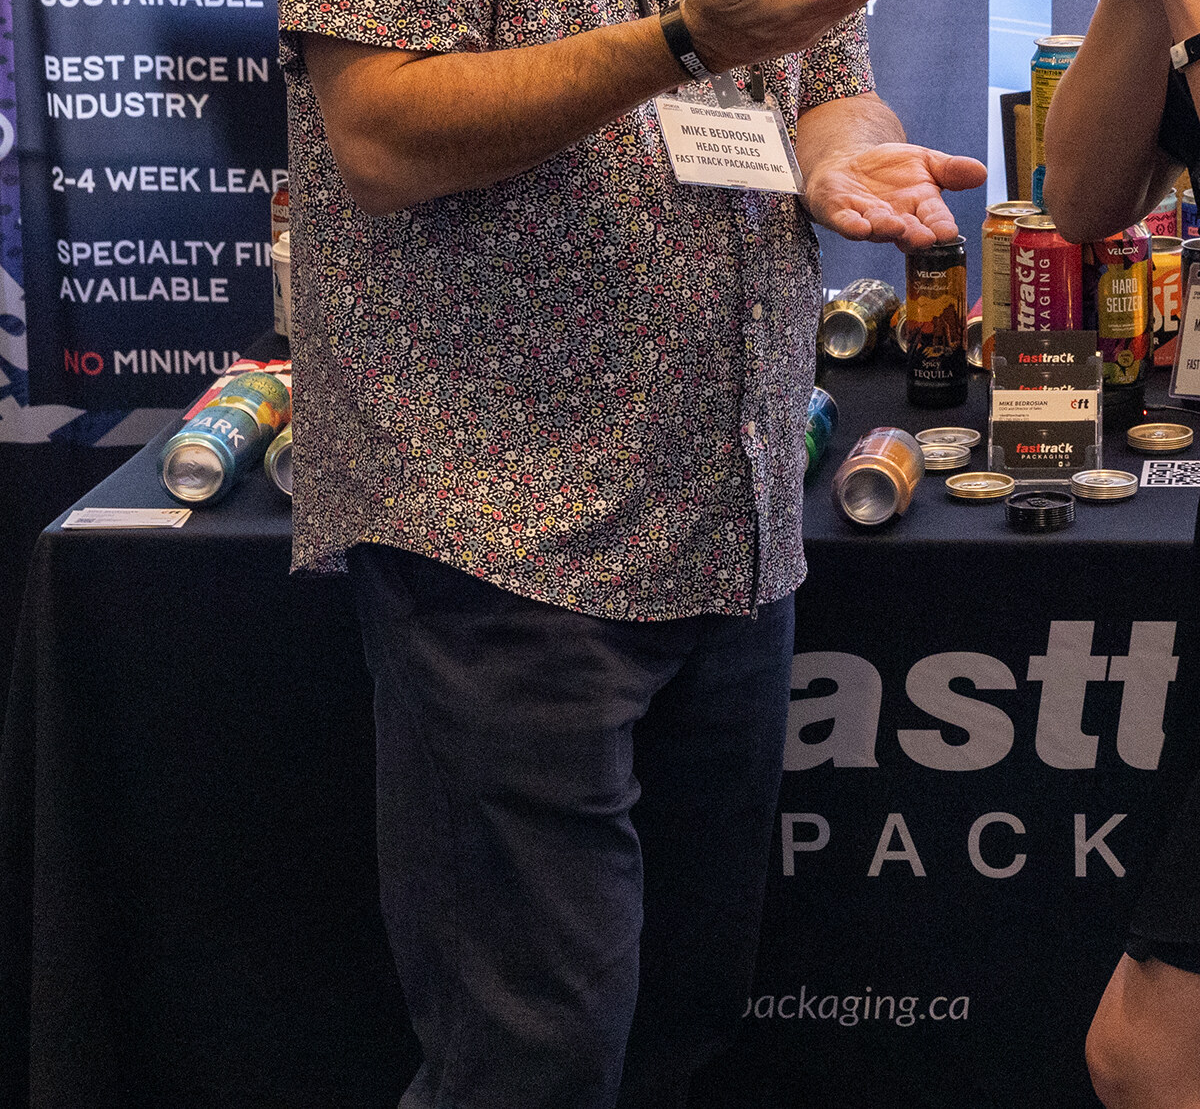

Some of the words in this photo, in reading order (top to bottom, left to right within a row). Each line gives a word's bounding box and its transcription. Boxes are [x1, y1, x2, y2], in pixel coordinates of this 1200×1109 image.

[45, 55, 126, 82] BEST
[134, 56, 229, 82] PRICE
[237, 56, 269, 82] IN
[47, 92, 208, 119] INDUSTRY
[680, 124, 709, 138] MIKE
[708, 127, 766, 144] BEDROSIAN
[695, 141, 720, 153] HEAD
[721, 144, 733, 155] OF
[734, 146, 761, 158] SALES
[675, 153, 695, 165] FAST
[696, 155, 724, 167] TRACK
[724, 157, 770, 172] PACKAGING
[52, 168, 96, 193] 2-4
[105, 166, 201, 192] WEEK
[57, 240, 226, 267] SPECIALTY
[1107, 246, 1139, 256] VELOX
[60, 277, 229, 303] AVAILABLE
[1111, 277, 1138, 294] HARD
[1106, 295, 1144, 313] SELTZER
[64, 349, 105, 375] NO
[1186, 358, 1200, 370] FAST
[913, 368, 954, 379] TEQUILA
[780, 811, 1128, 879] PACK
